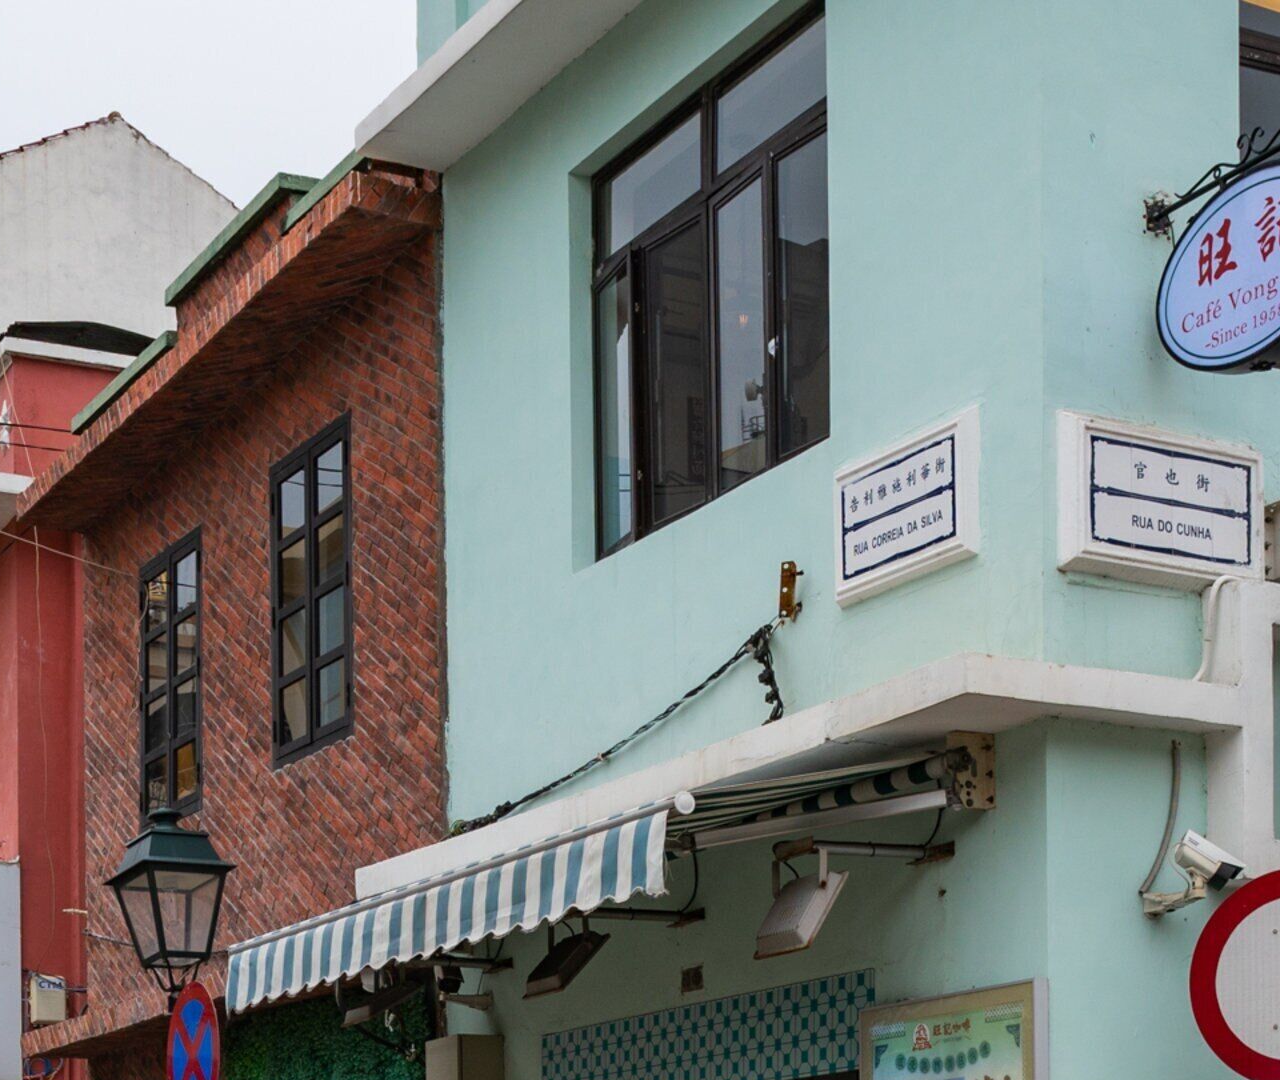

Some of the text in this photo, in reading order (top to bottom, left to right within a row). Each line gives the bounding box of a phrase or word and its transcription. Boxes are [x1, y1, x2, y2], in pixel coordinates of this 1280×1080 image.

[1180, 299, 1223, 335] Café
[1227, 274, 1280, 311] Vong
[1133, 460, 1211, 493] 官也街
[853, 509, 944, 557] RUA CORREIA DA SILVA
[1131, 513, 1212, 541] RUA DO CUNHA
